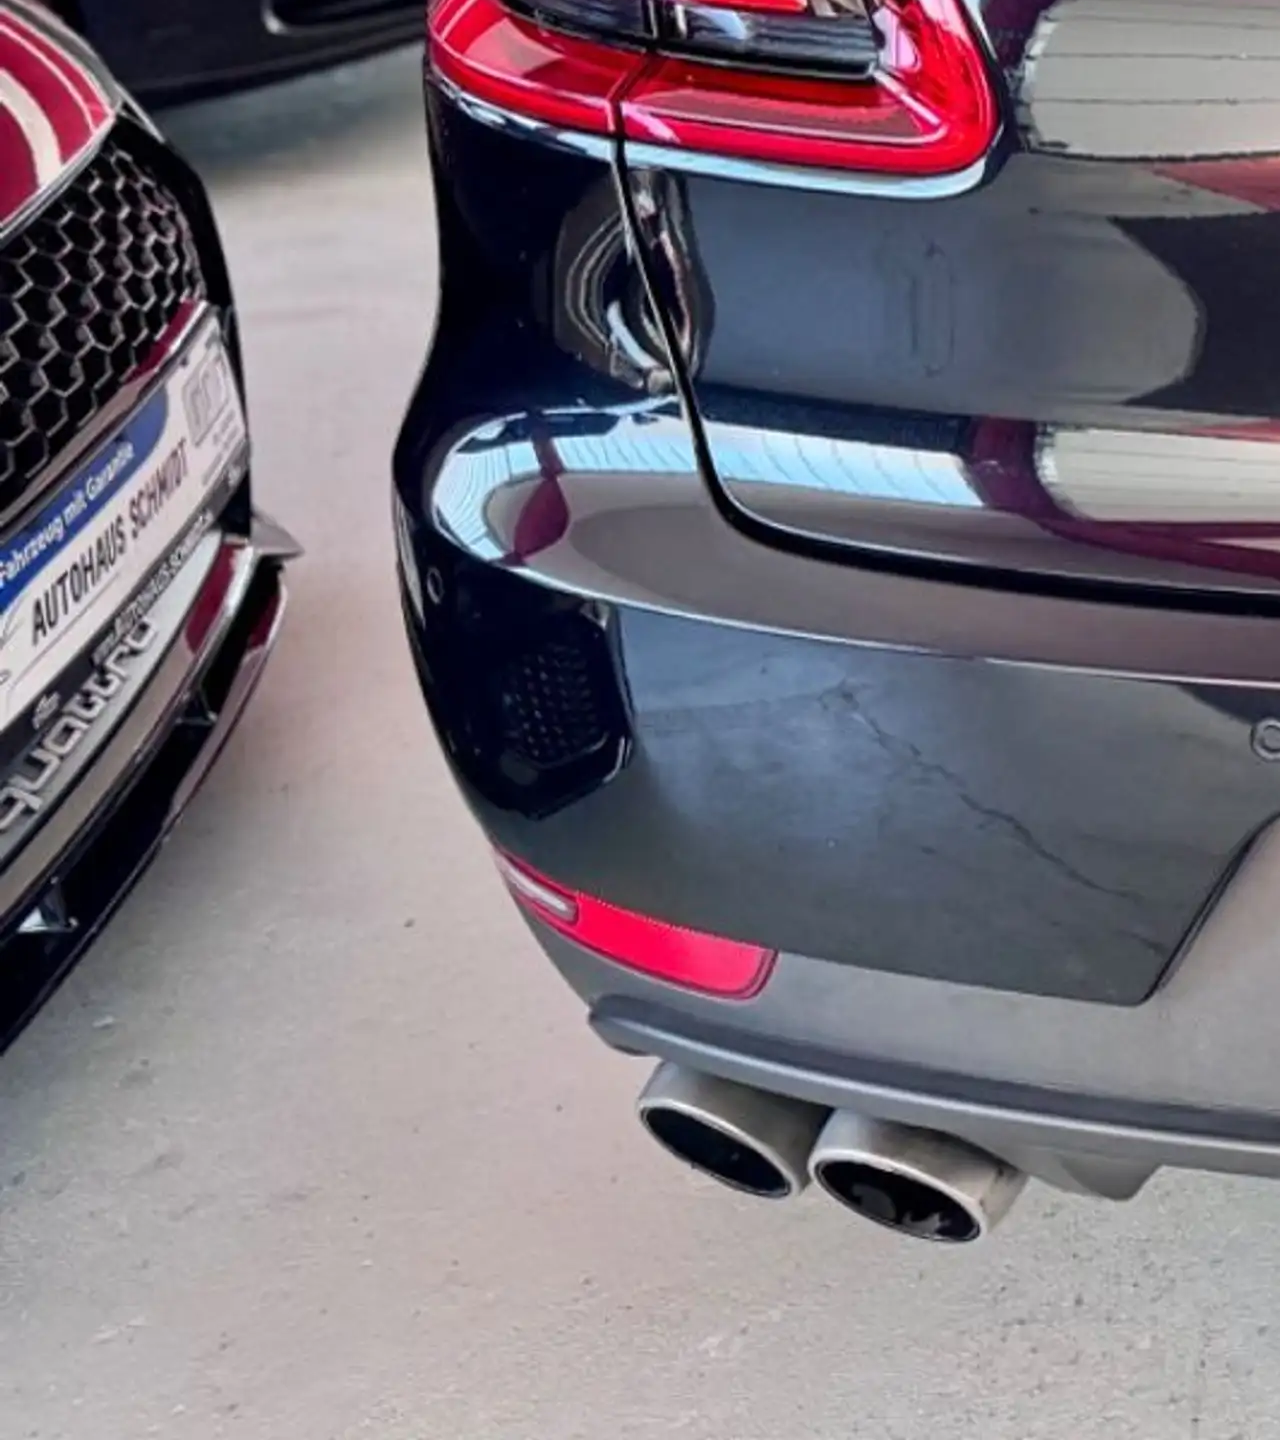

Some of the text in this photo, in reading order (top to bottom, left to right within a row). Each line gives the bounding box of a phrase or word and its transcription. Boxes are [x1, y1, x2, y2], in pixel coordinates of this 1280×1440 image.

[32, 438, 189, 646] AUTOHAUS SCHMIDT
[62, 489, 88, 527] mit
